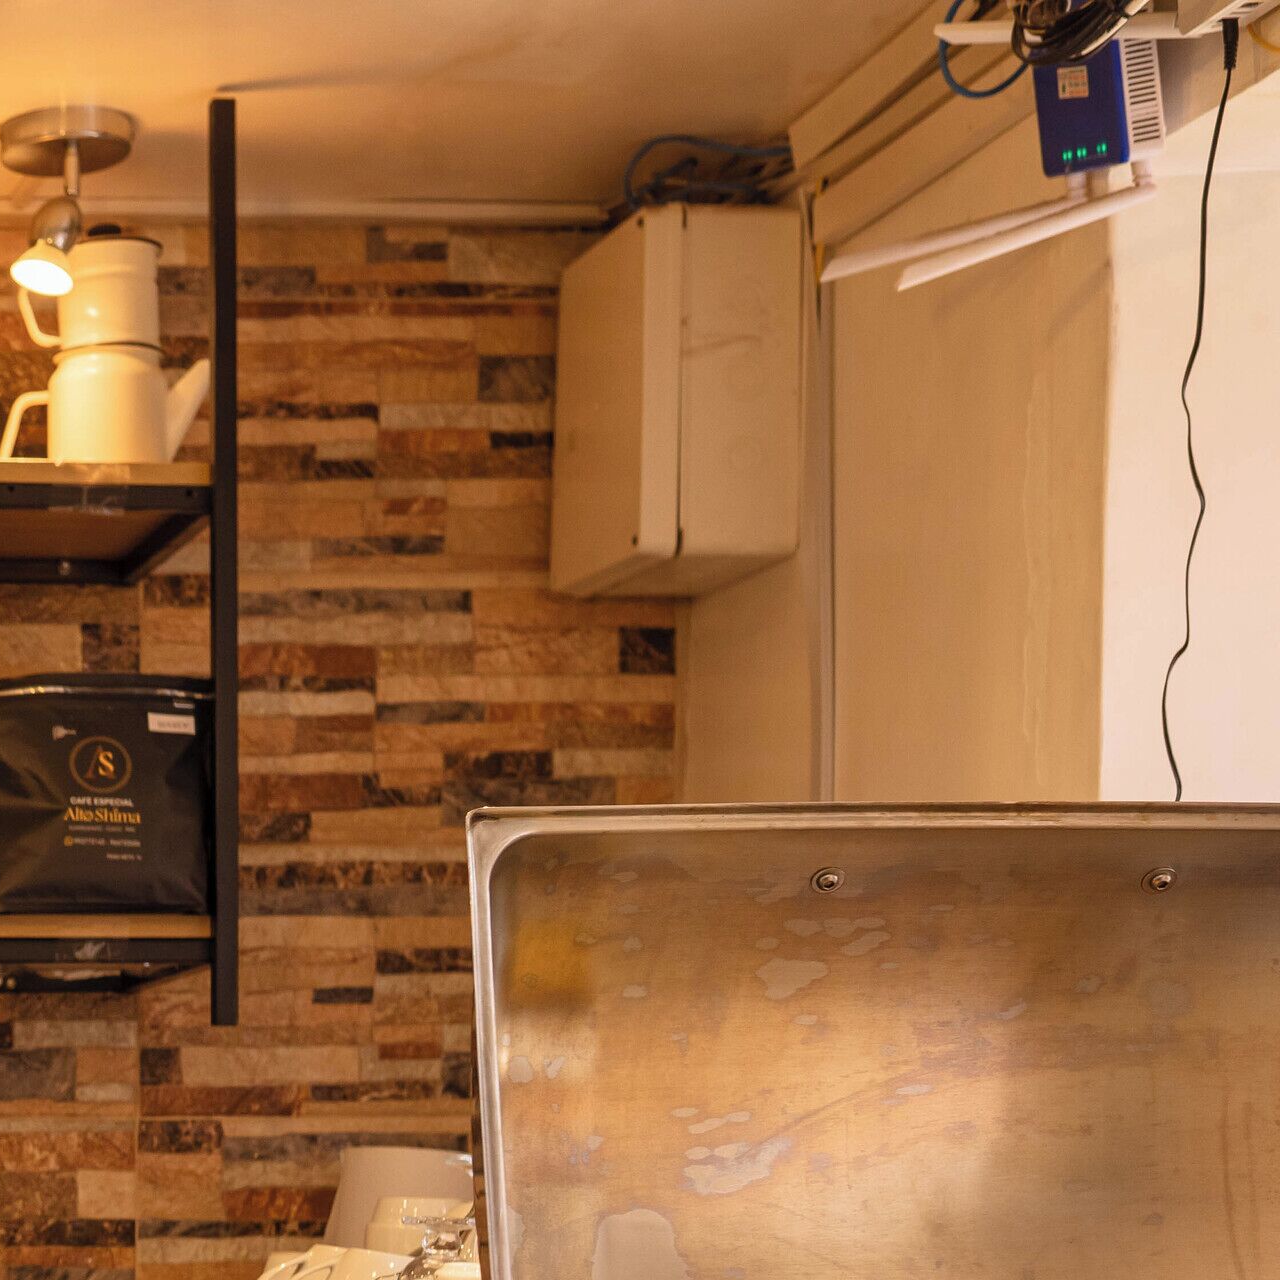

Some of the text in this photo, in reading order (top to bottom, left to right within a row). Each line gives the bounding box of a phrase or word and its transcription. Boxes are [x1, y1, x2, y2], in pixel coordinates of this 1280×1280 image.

[93, 796, 134, 808] ESPECIAL
[63, 806, 142, 825] Alto Shima
